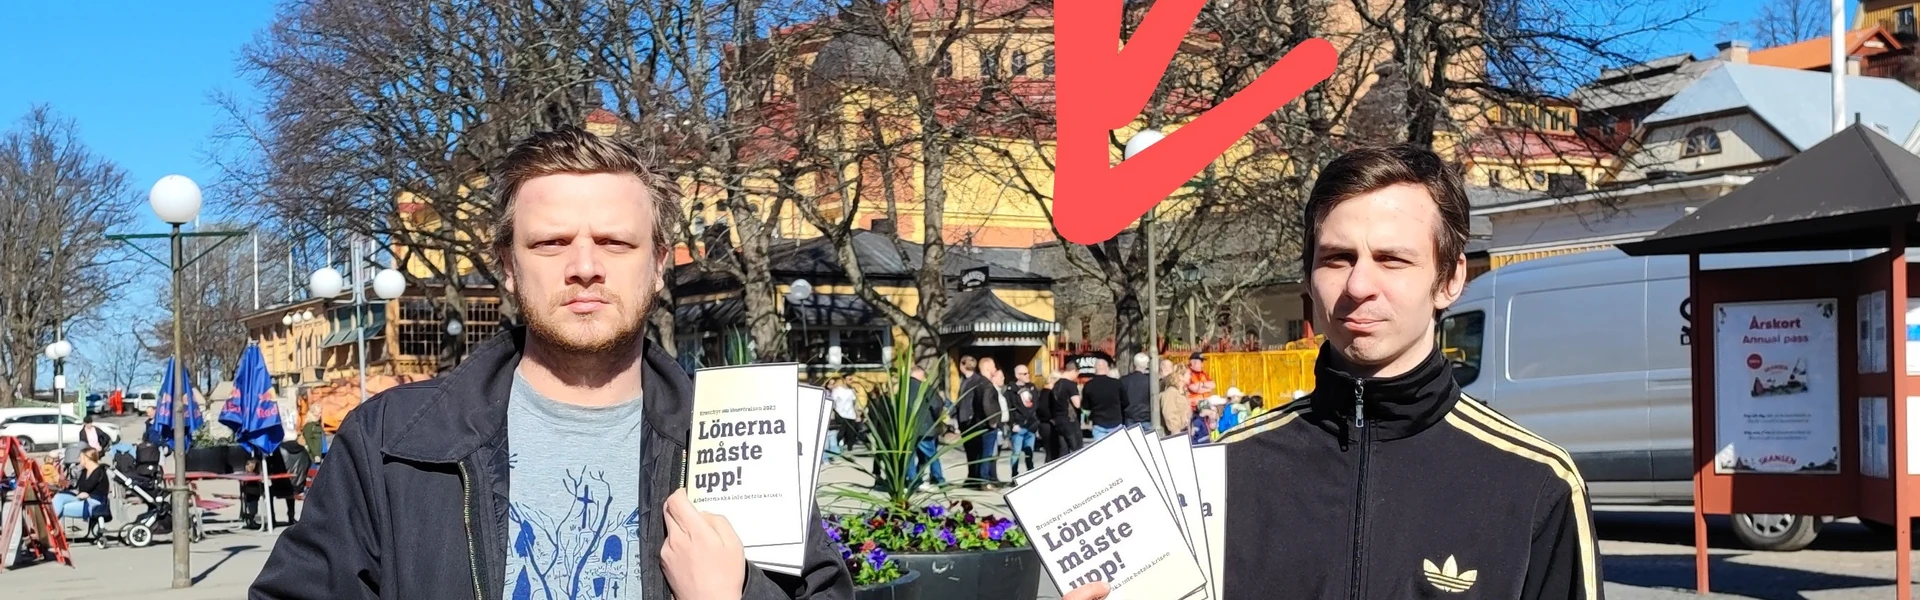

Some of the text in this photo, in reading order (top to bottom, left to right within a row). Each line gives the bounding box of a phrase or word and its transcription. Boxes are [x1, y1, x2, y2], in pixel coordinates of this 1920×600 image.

[1749, 315, 1801, 331] Årskort
[1742, 334, 1809, 344] Annual pass
[698, 418, 786, 440] Lönerna
[696, 441, 763, 465] måste
[694, 466, 743, 492] upp!
[1041, 485, 1147, 552] Lönerna
[1056, 521, 1134, 574] måste
